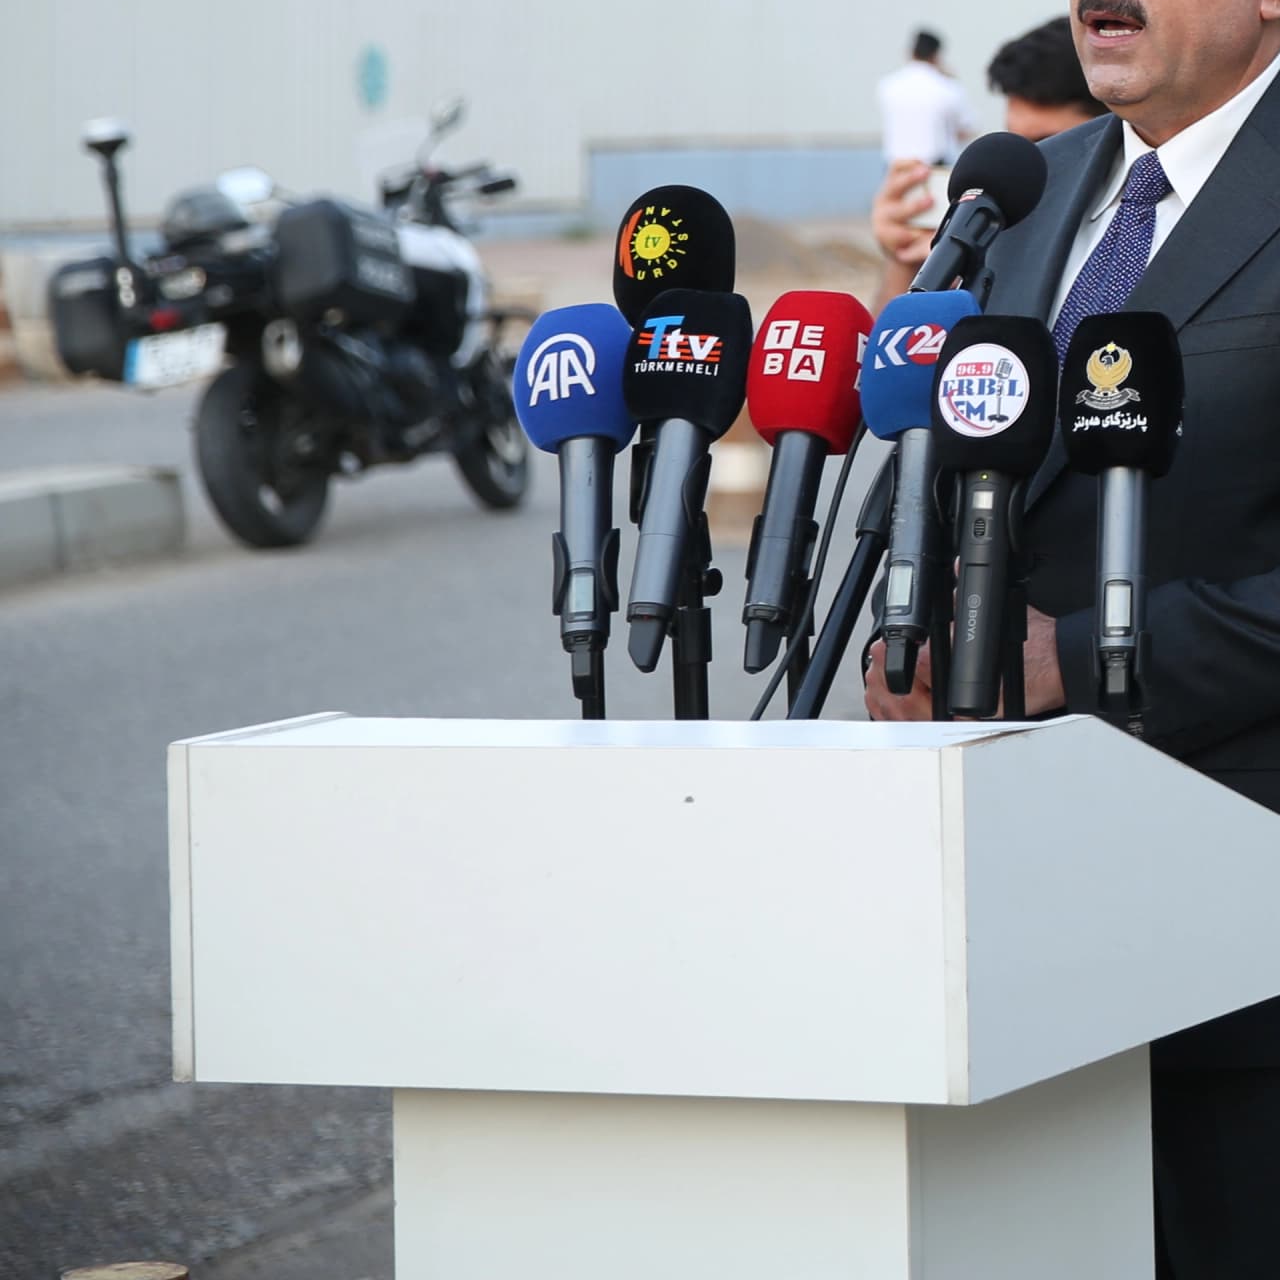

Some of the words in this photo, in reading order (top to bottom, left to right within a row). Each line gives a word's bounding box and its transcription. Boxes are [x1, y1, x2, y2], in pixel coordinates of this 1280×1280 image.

[528, 349, 596, 407] AA
[957, 364, 992, 375] 96.9
[966, 609, 979, 643] BOYA
